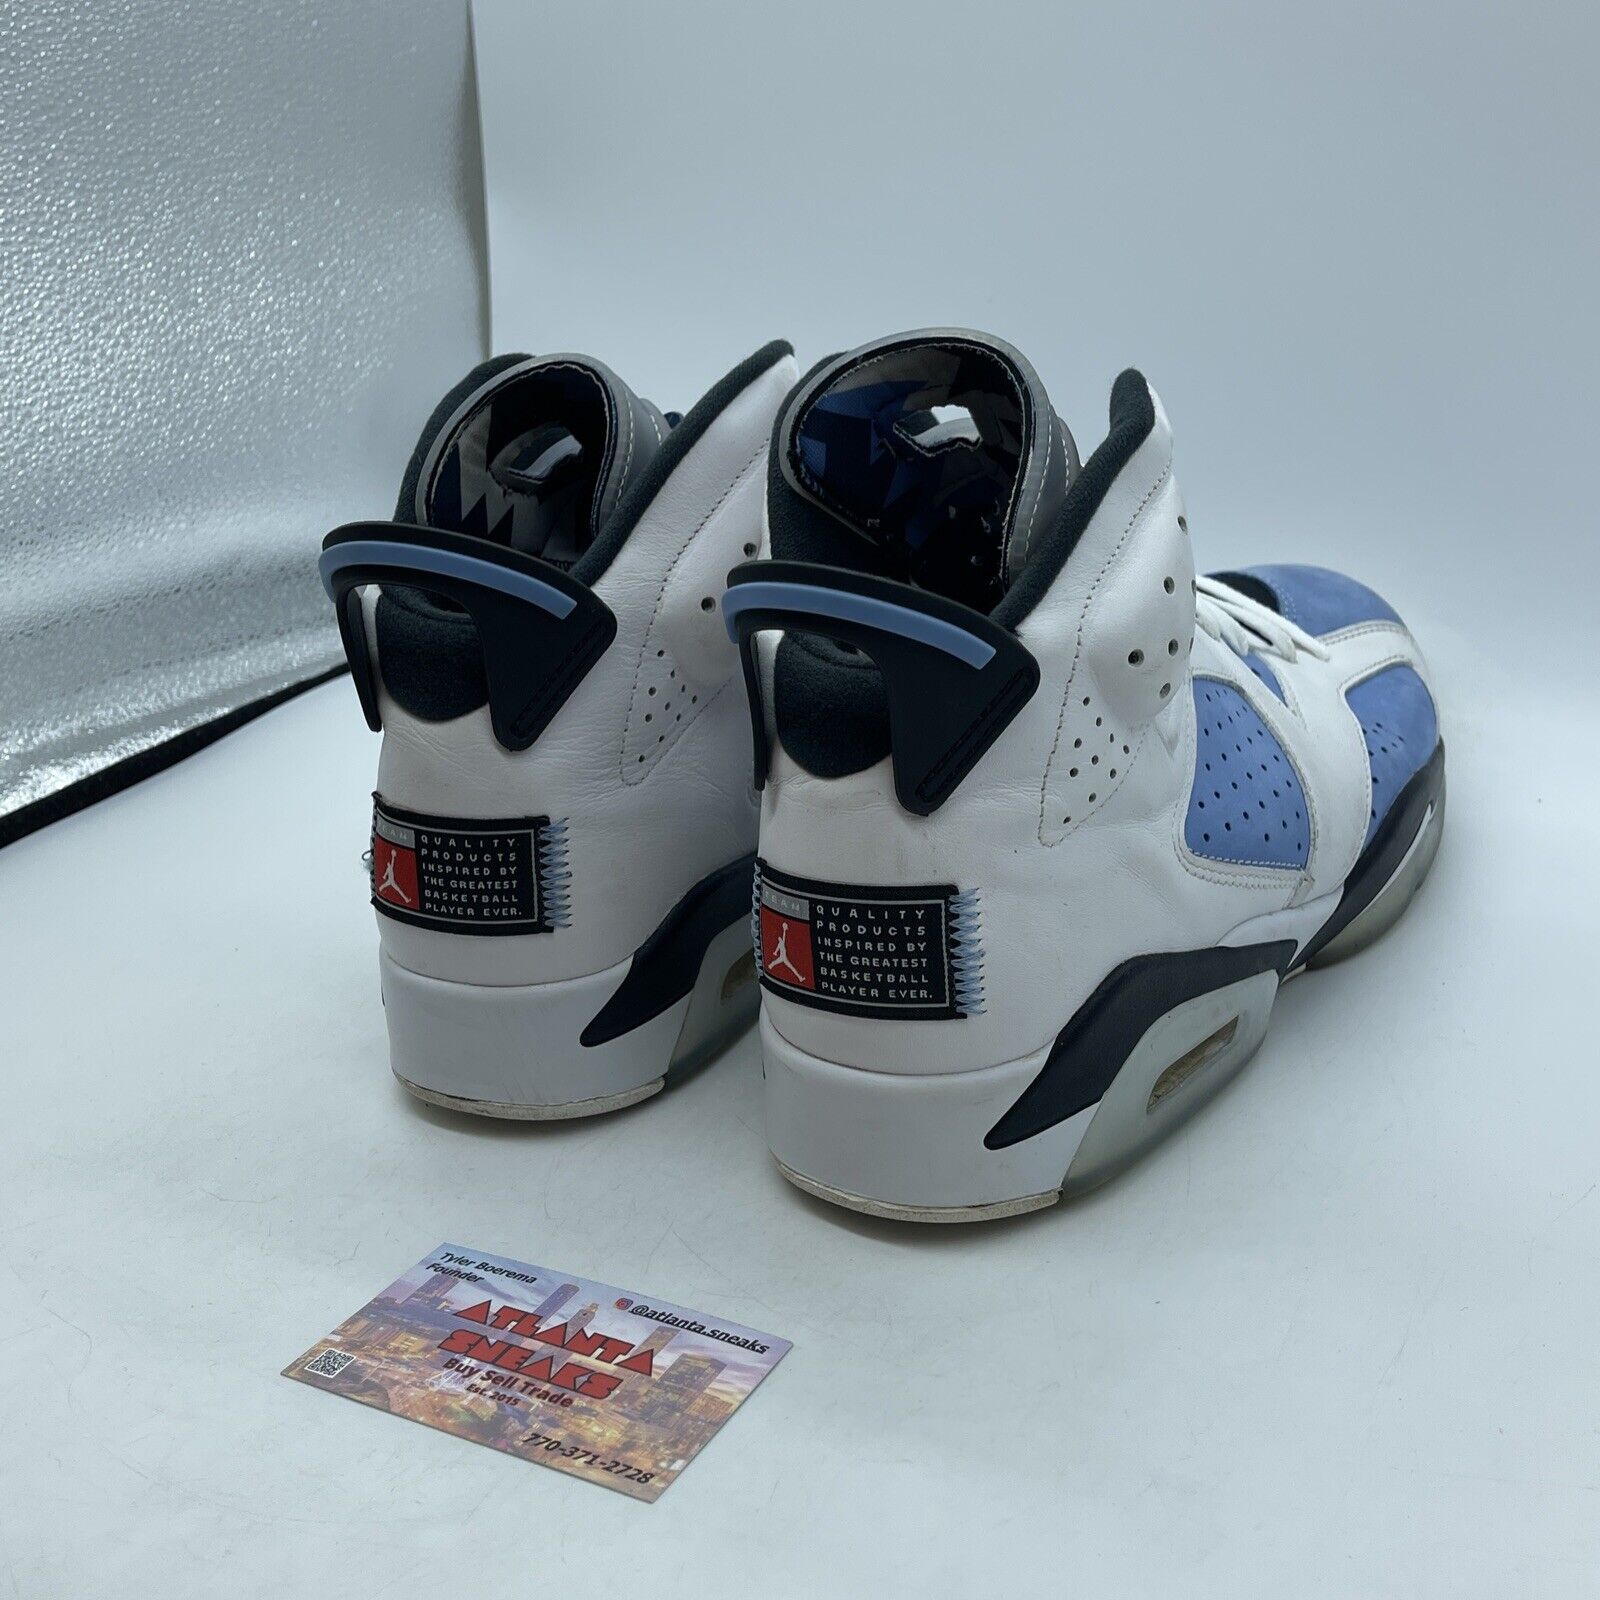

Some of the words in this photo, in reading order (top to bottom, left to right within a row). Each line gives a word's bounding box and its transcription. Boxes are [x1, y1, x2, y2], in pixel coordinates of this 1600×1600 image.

[421, 835, 516, 847] QUALITY
[421, 849, 516, 861] PRODUCTS
[422, 863, 490, 876] INSPIRED
[500, 867, 517, 876] BY
[424, 876, 444, 886] THE
[450, 880, 517, 889] GREATEST
[425, 890, 518, 903] BASKETBALL
[426, 904, 474, 915] PLAYER
[484, 908, 522, 916] EVER.
[816, 905, 925, 919] QUALITY
[817, 920, 926, 935] PRODUCTS
[818, 937, 896, 952] INSPIRED
[908, 942, 926, 952] BY
[819, 952, 843, 964] THE
[851, 956, 927, 967] GREATEST
[820, 967, 929, 983] BASKETBALL
[822, 981, 879, 998] PLAYER
[889, 990, 932, 998] EVER.
[426, 1262, 484, 1285] Founder
[439, 1252, 476, 1269] Tyler
[475, 1261, 538, 1285] Boerema
[629, 1301, 770, 1355] @atlanta.sneaks
[452, 1299, 653, 1377] ATLANTA
[437, 1328, 624, 1400] SNEAKS
[442, 1357, 481, 1380] Buy
[480, 1366, 519, 1391] Sell
[522, 1380, 575, 1408] Trade
[466, 1383, 491, 1397] Est.
[489, 1390, 521, 1407] 2015
[523, 1432, 656, 1485] 770-371-2728
